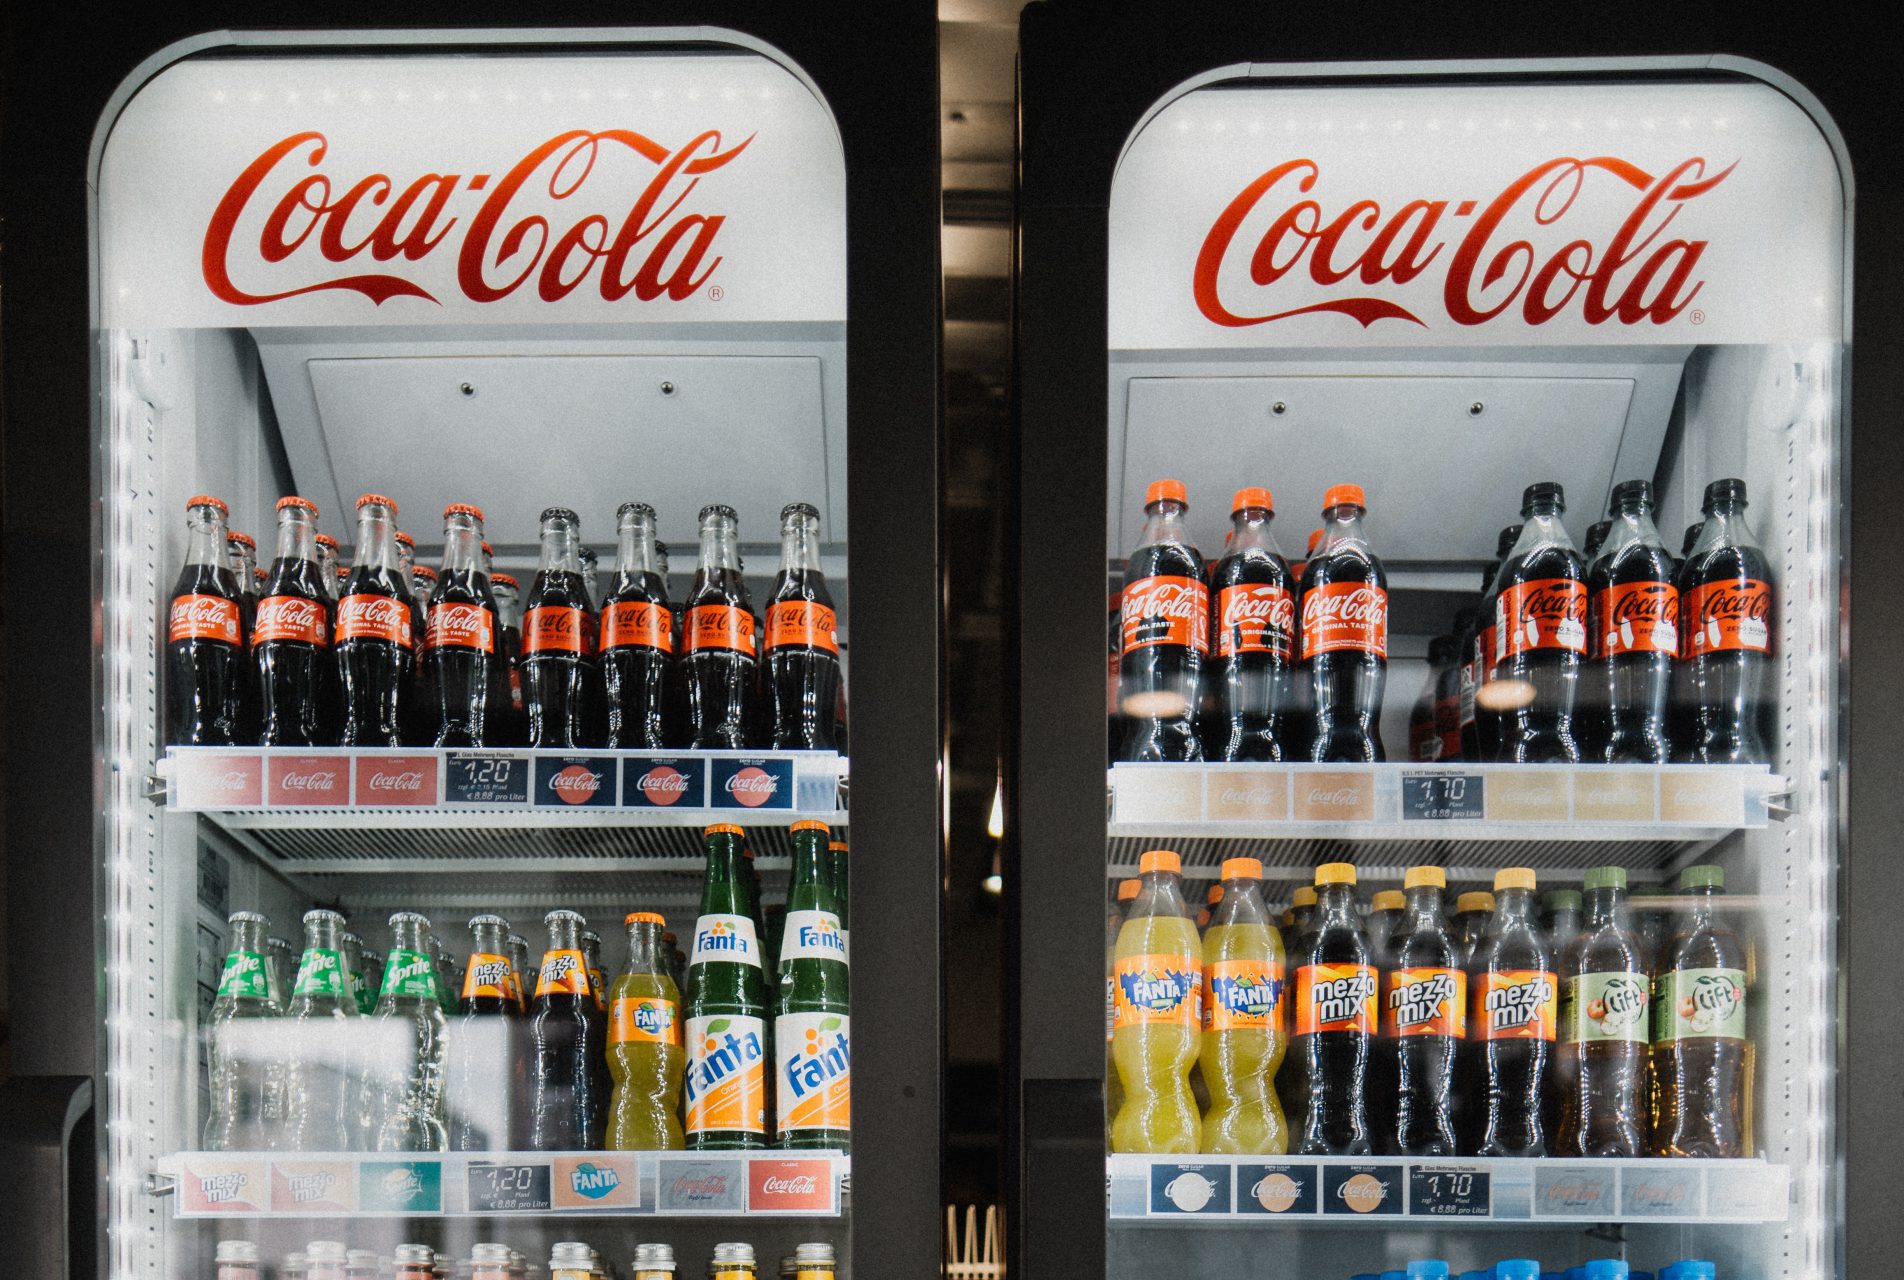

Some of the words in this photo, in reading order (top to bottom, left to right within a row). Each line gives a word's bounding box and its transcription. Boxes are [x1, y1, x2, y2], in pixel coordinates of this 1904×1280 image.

[201, 130, 758, 306] Coca-Cola
[1192, 156, 1743, 329] Coca-Cola
[1303, 588, 1385, 629] Coca-Cola
[1242, 629, 1275, 637] ORIGINAL
[282, 771, 335, 790] Coca-Cola
[370, 771, 423, 790] Coca-Cola
[465, 760, 511, 784] 1,20
[549, 772, 603, 791] Coca-Cola
[637, 772, 690, 791] Coca-Cola
[725, 773, 779, 792] Coca-Cola
[509, 792, 526, 800] Liter
[1421, 778, 1466, 801] 1,70
[698, 930, 748, 954] Fanta
[800, 926, 845, 950] Fanta
[387, 957, 431, 989] Sprite
[471, 960, 510, 979] mezzo
[475, 971, 503, 986] mix
[542, 968, 567, 985] mix
[1133, 980, 1181, 1003] FANTA
[1228, 985, 1274, 1006] FANTA
[1312, 971, 1376, 1002] mezzo
[1388, 973, 1457, 1008] mezzo
[1485, 978, 1552, 1011] mezzo
[633, 1006, 672, 1029] FANTA
[1321, 996, 1365, 1021] mix
[1396, 995, 1442, 1026] mix
[1494, 1002, 1540, 1028] mix
[686, 1031, 763, 1103] Fanta
[201, 1172, 247, 1190] mezzo
[487, 1167, 532, 1192] 1,20
[571, 1170, 619, 1192] FANTA
[763, 1176, 817, 1194] Coca-Cola
[1428, 1173, 1472, 1197] 1,70
[207, 1185, 240, 1202] mix
[1472, 1206, 1488, 1214] Liter
